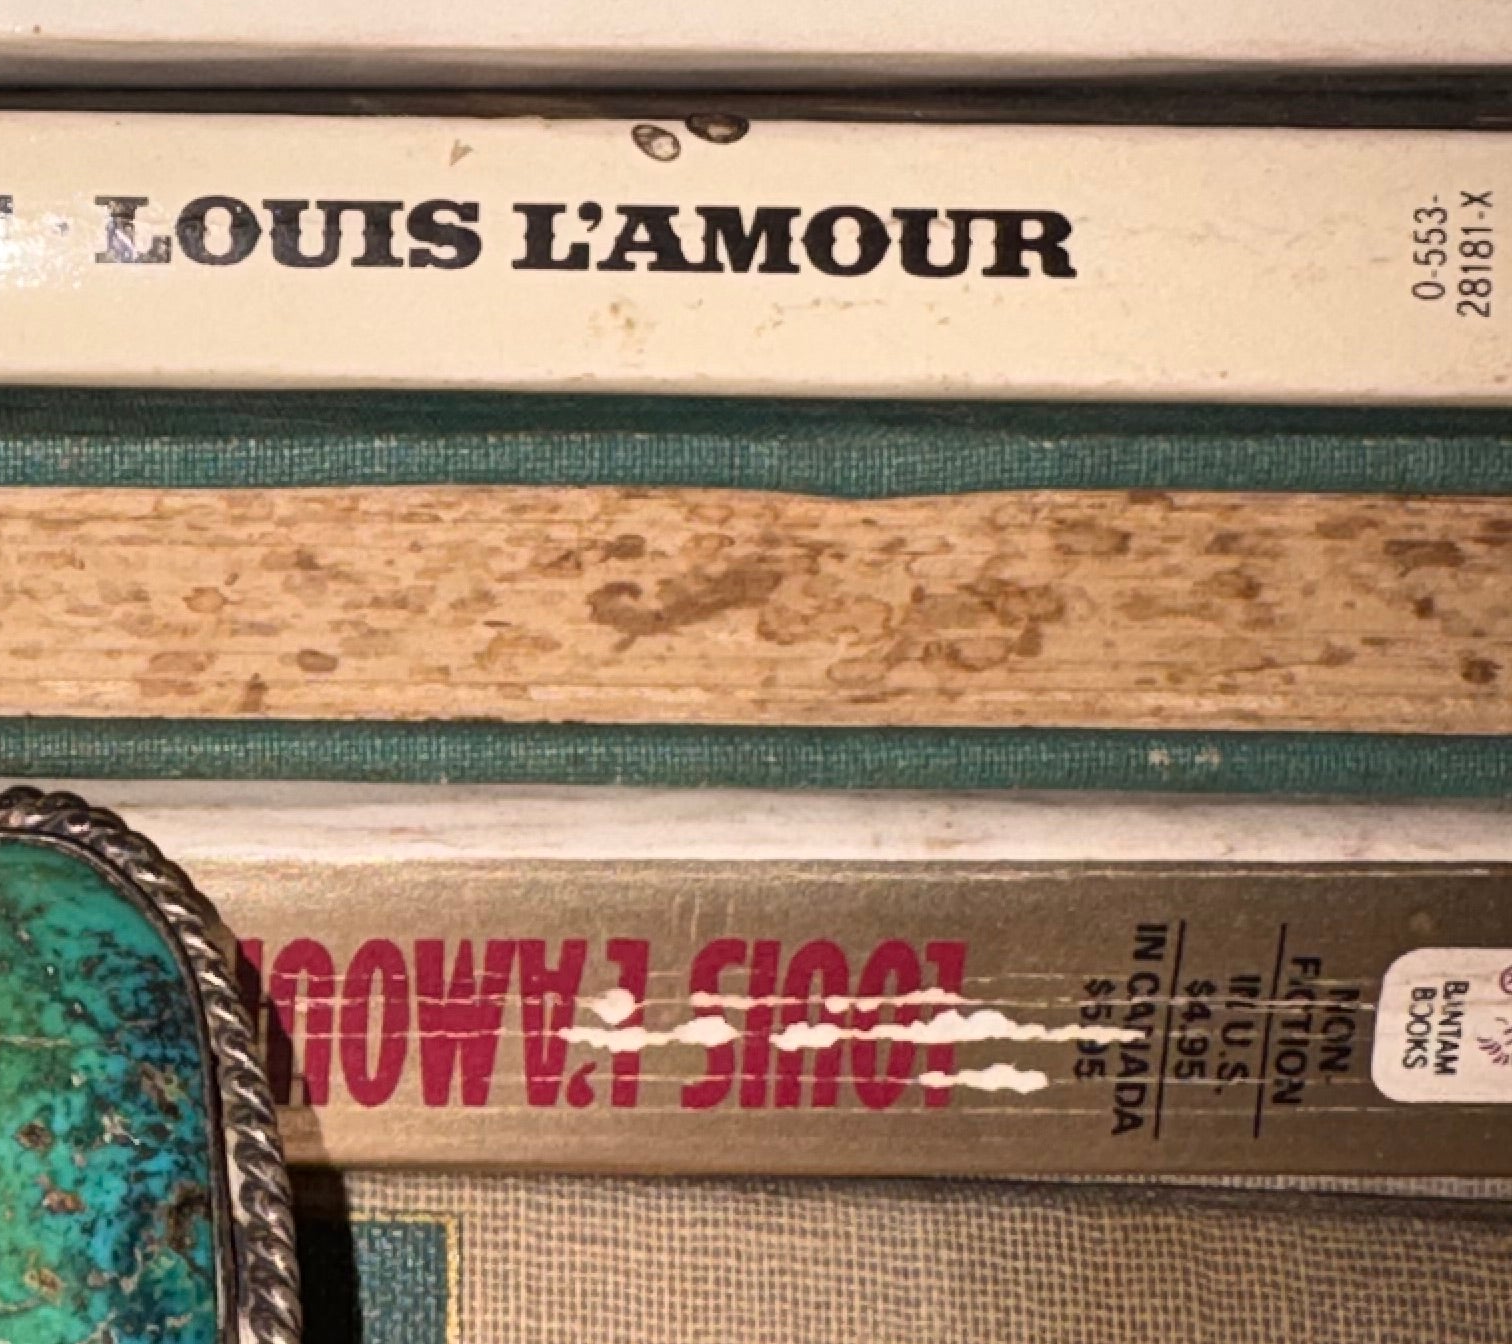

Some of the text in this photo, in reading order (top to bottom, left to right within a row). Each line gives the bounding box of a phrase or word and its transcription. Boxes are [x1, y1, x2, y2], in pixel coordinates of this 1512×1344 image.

[93, 195, 1076, 278] LOUIS L'AMOUR
[1411, 193, 1448, 301] 0-553-
[1456, 191, 1494, 317] 28181-X
[1132, 923, 1168, 961] IN
[680, 937, 968, 1110] LOUIS
[1073, 978, 1116, 1081] $595
[1174, 978, 1217, 1080] $4.95
[1402, 986, 1437, 1069] BOOKS
